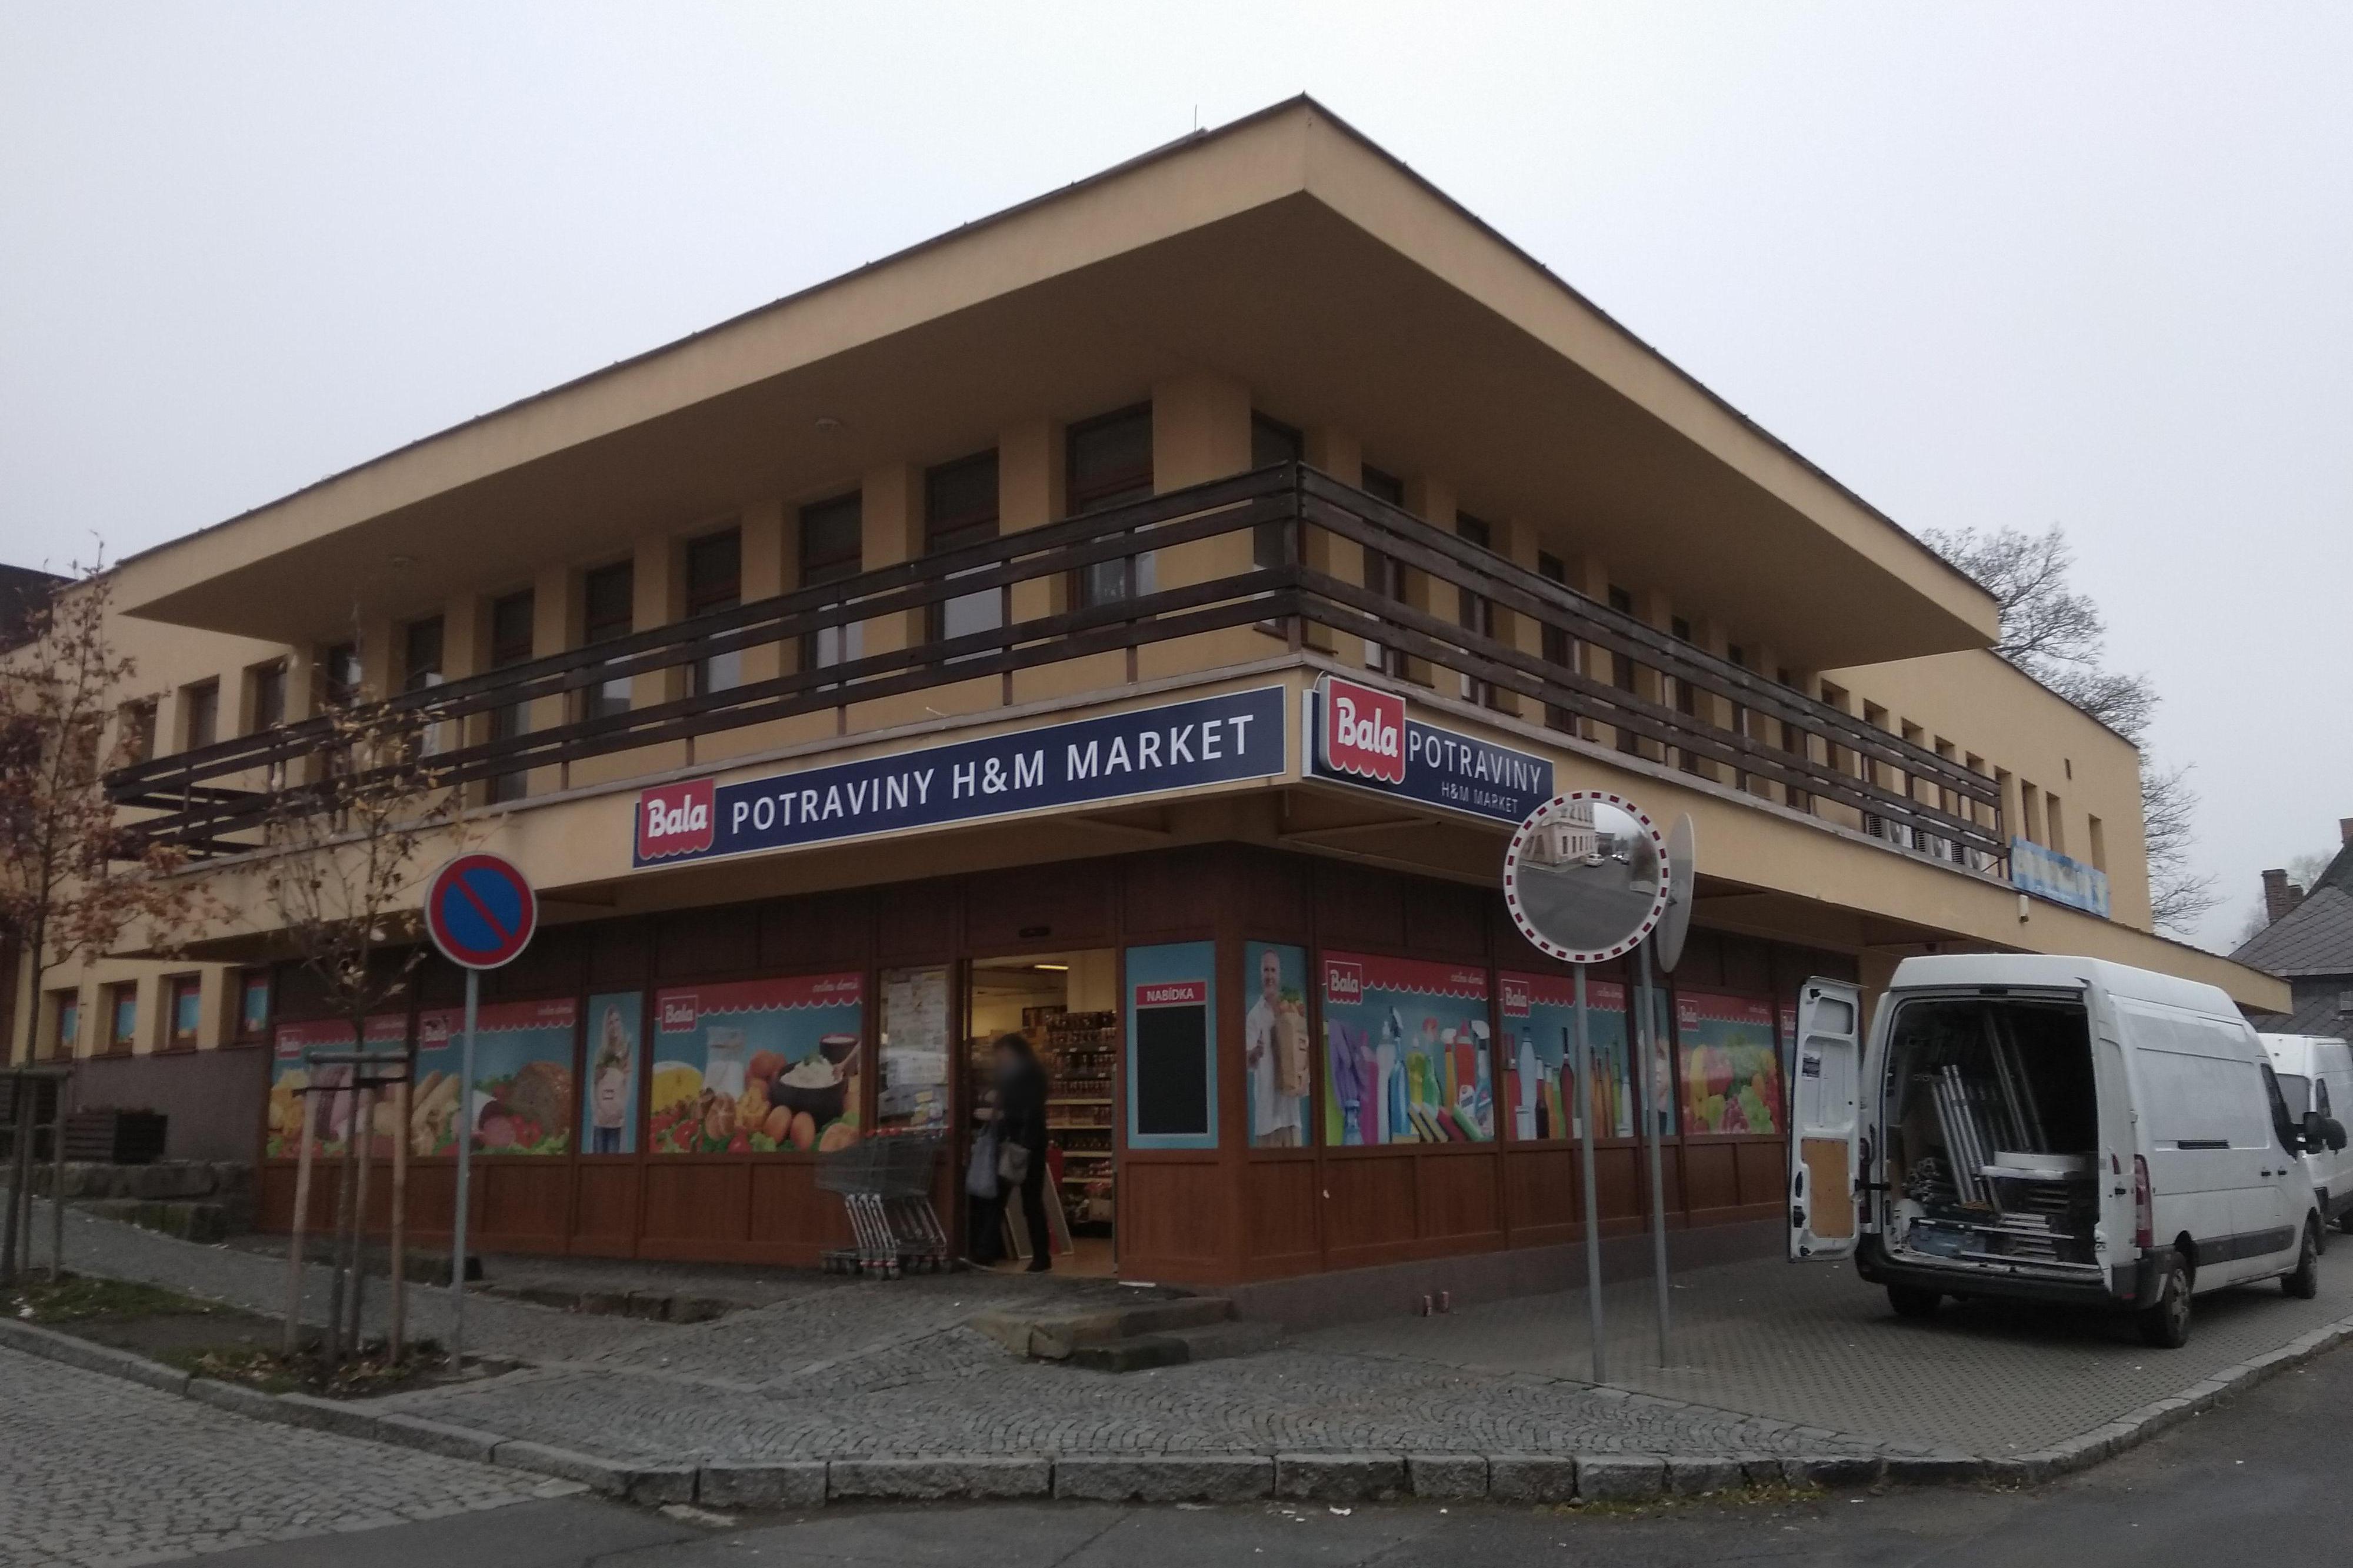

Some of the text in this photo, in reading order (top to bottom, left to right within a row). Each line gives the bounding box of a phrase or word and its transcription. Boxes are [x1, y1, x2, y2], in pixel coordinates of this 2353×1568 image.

[1336, 697, 1398, 757] Bala
[731, 714, 1255, 835] POTRAVINY H&M MARKET
[1409, 729, 1542, 795] POTRAVINY
[1441, 781, 1518, 814] H&M MARKET
[646, 795, 708, 839] Bala
[1146, 987, 1194, 1002] NABÍDKA
[1330, 969, 1359, 993] Bala
[1505, 986, 1527, 1007] Bala
[665, 1003, 694, 1023] Bala
